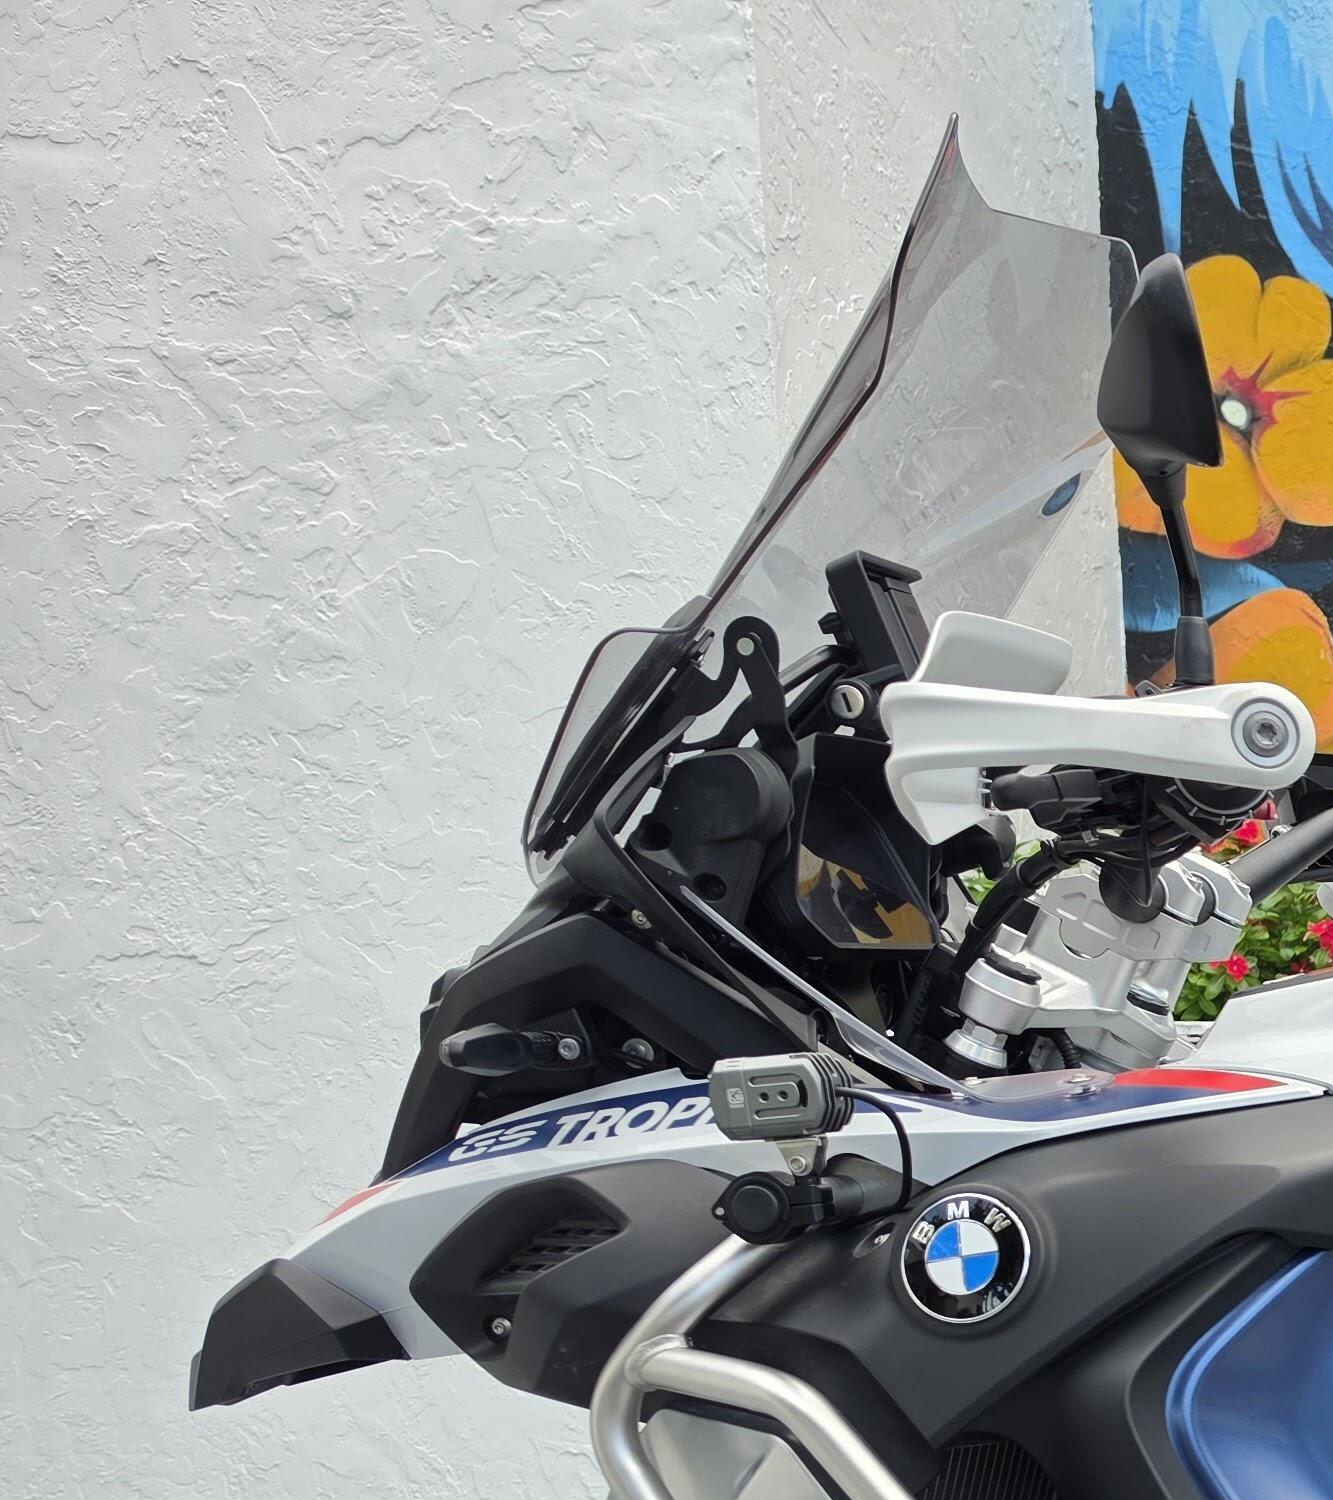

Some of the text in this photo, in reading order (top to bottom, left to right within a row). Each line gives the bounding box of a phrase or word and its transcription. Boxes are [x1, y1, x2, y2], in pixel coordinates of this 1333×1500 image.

[448, 1119, 550, 1162] GS
[545, 1096, 717, 1149] TROP
[910, 1200, 1014, 1247] BMW
